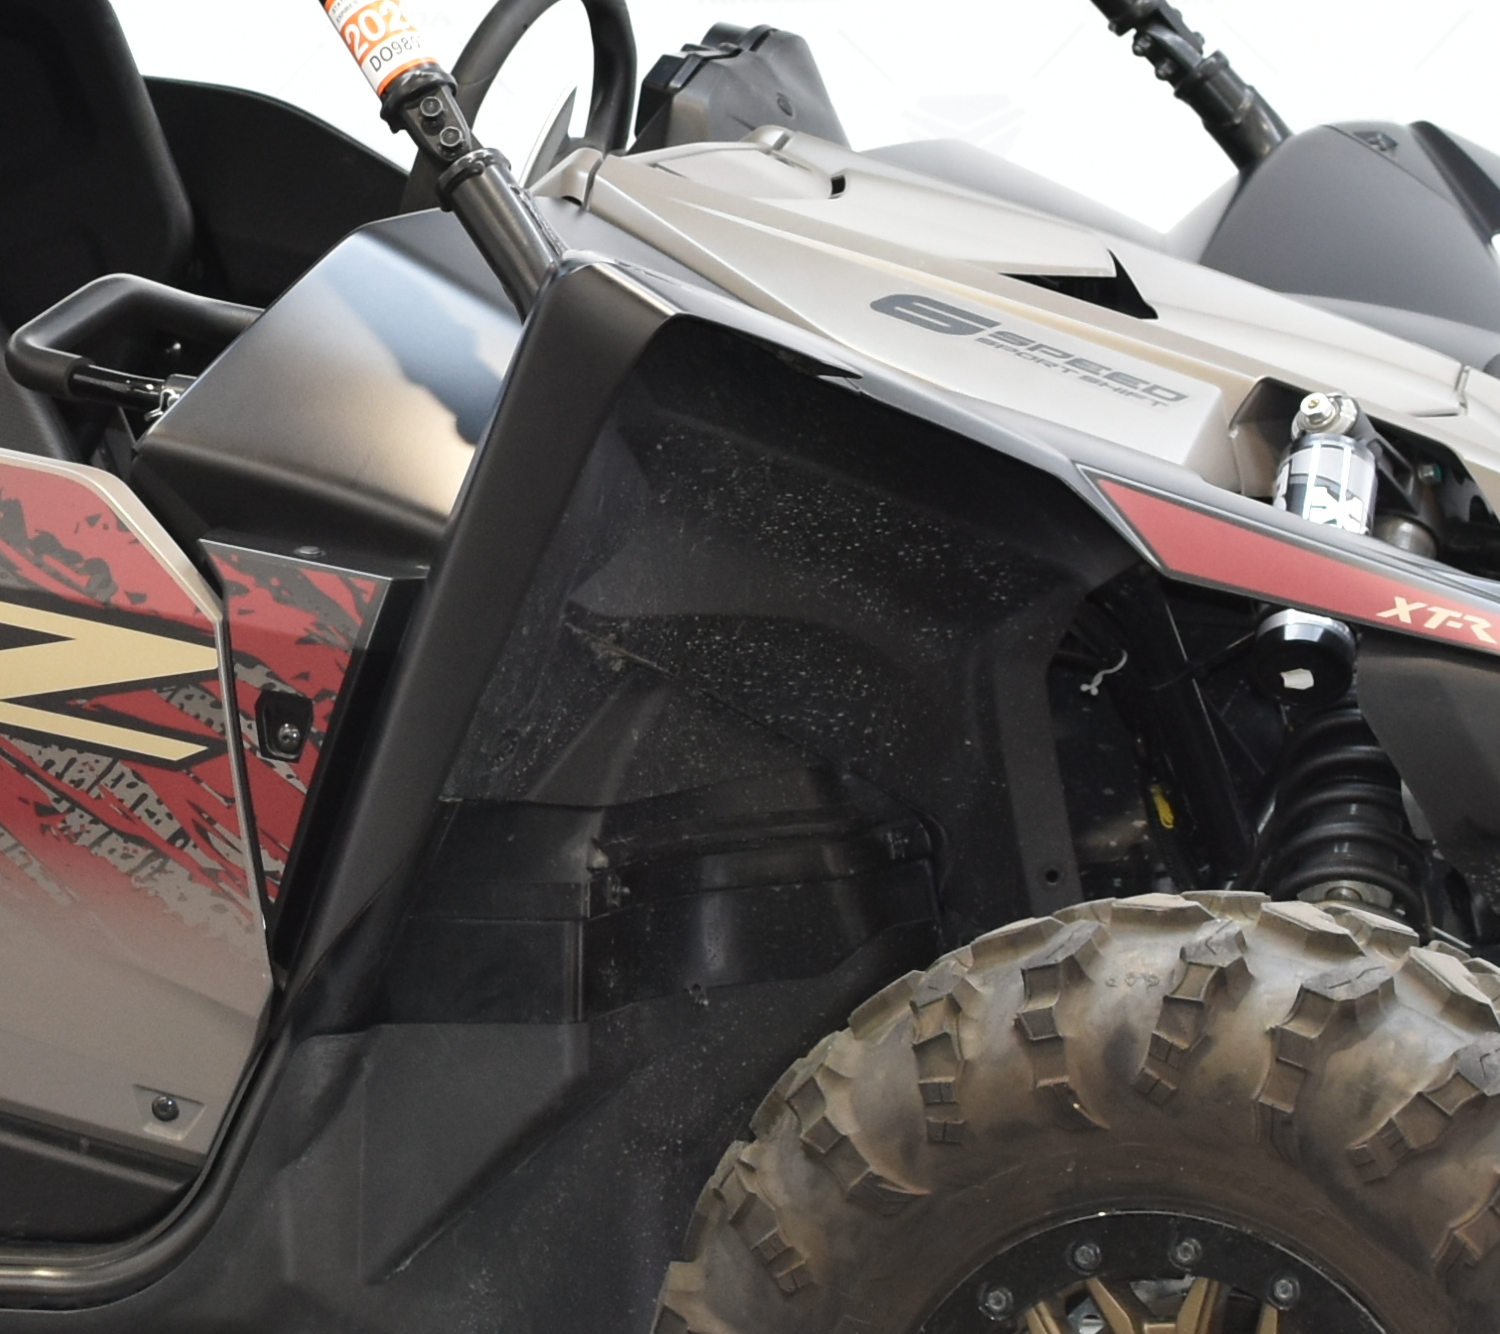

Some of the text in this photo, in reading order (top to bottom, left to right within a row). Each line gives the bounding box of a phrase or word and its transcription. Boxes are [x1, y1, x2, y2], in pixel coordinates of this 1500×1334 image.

[870, 294, 1189, 403] 6 SPEED
[1376, 596, 1498, 644] XT-R
